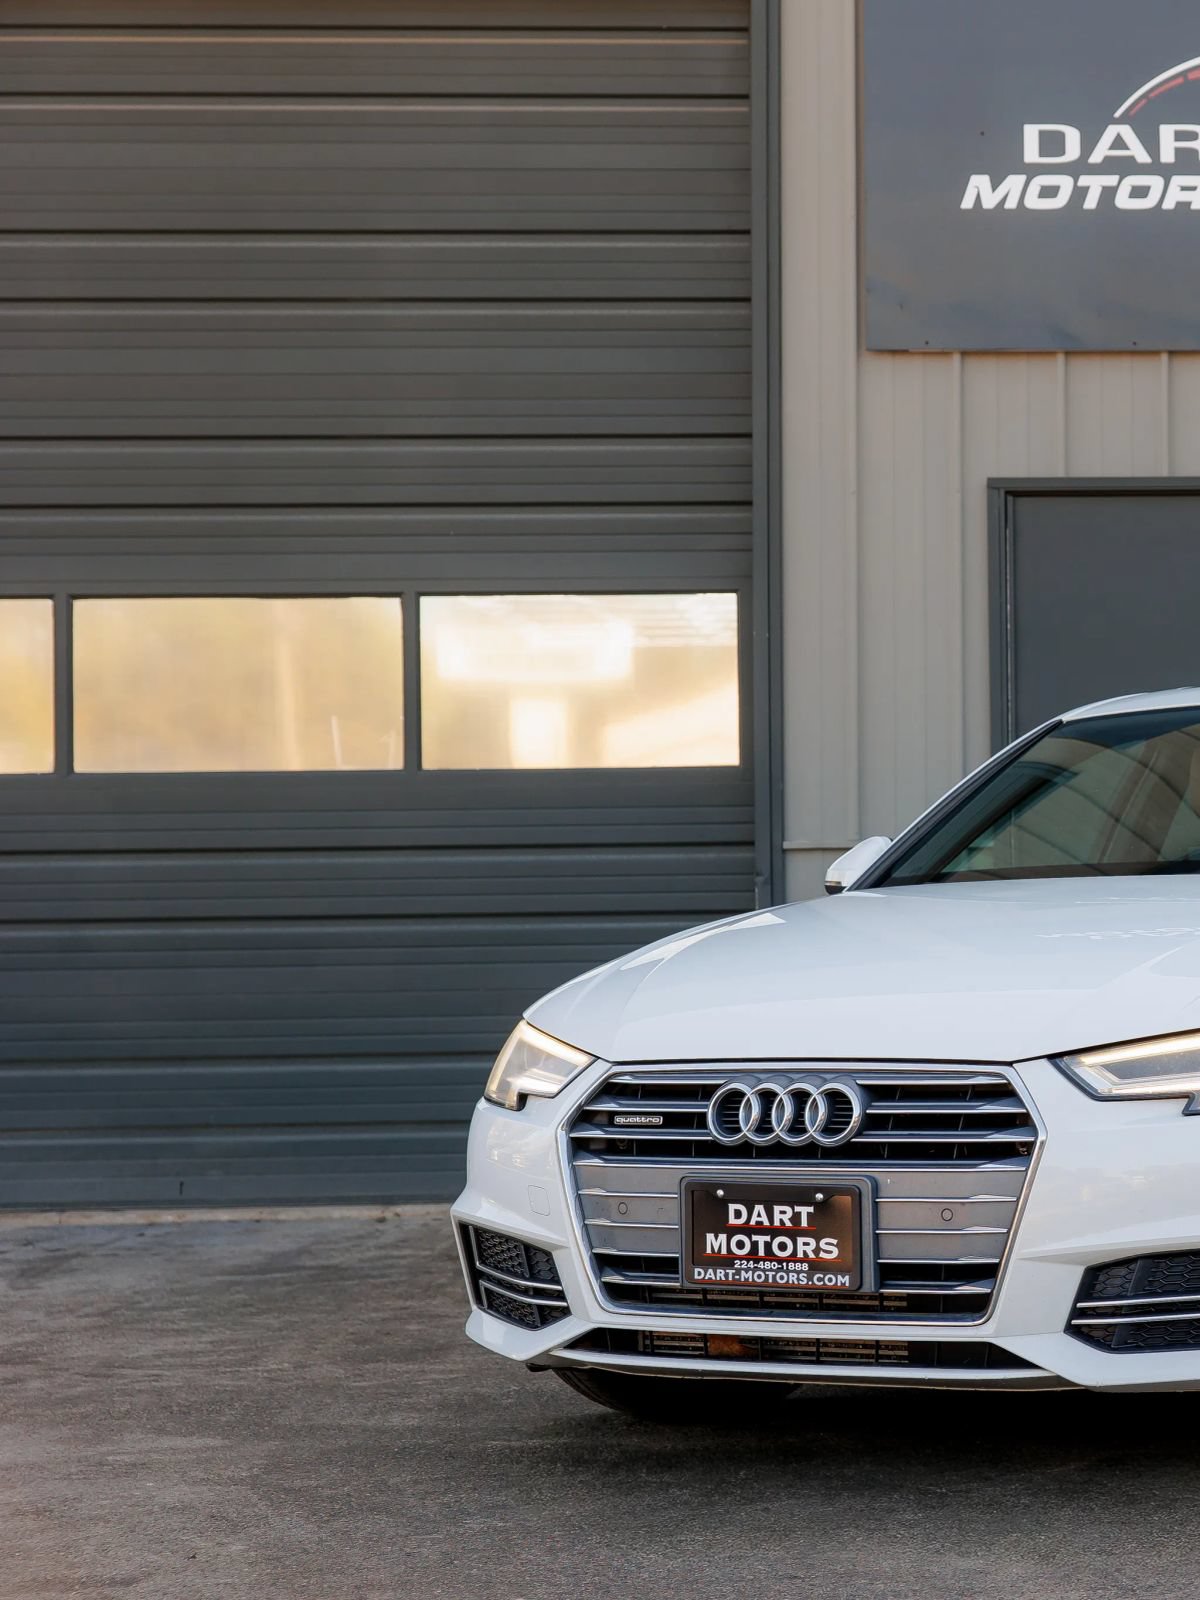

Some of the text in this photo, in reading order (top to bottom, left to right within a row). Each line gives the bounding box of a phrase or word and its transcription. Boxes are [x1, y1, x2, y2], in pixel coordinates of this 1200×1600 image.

[616, 1116, 660, 1124] quattro
[727, 1203, 815, 1227] DART
[705, 1233, 839, 1259] MOTORS
[734, 1259, 809, 1271] 224-480-1888
[694, 1267, 850, 1287] DART-MOTORS.COM
